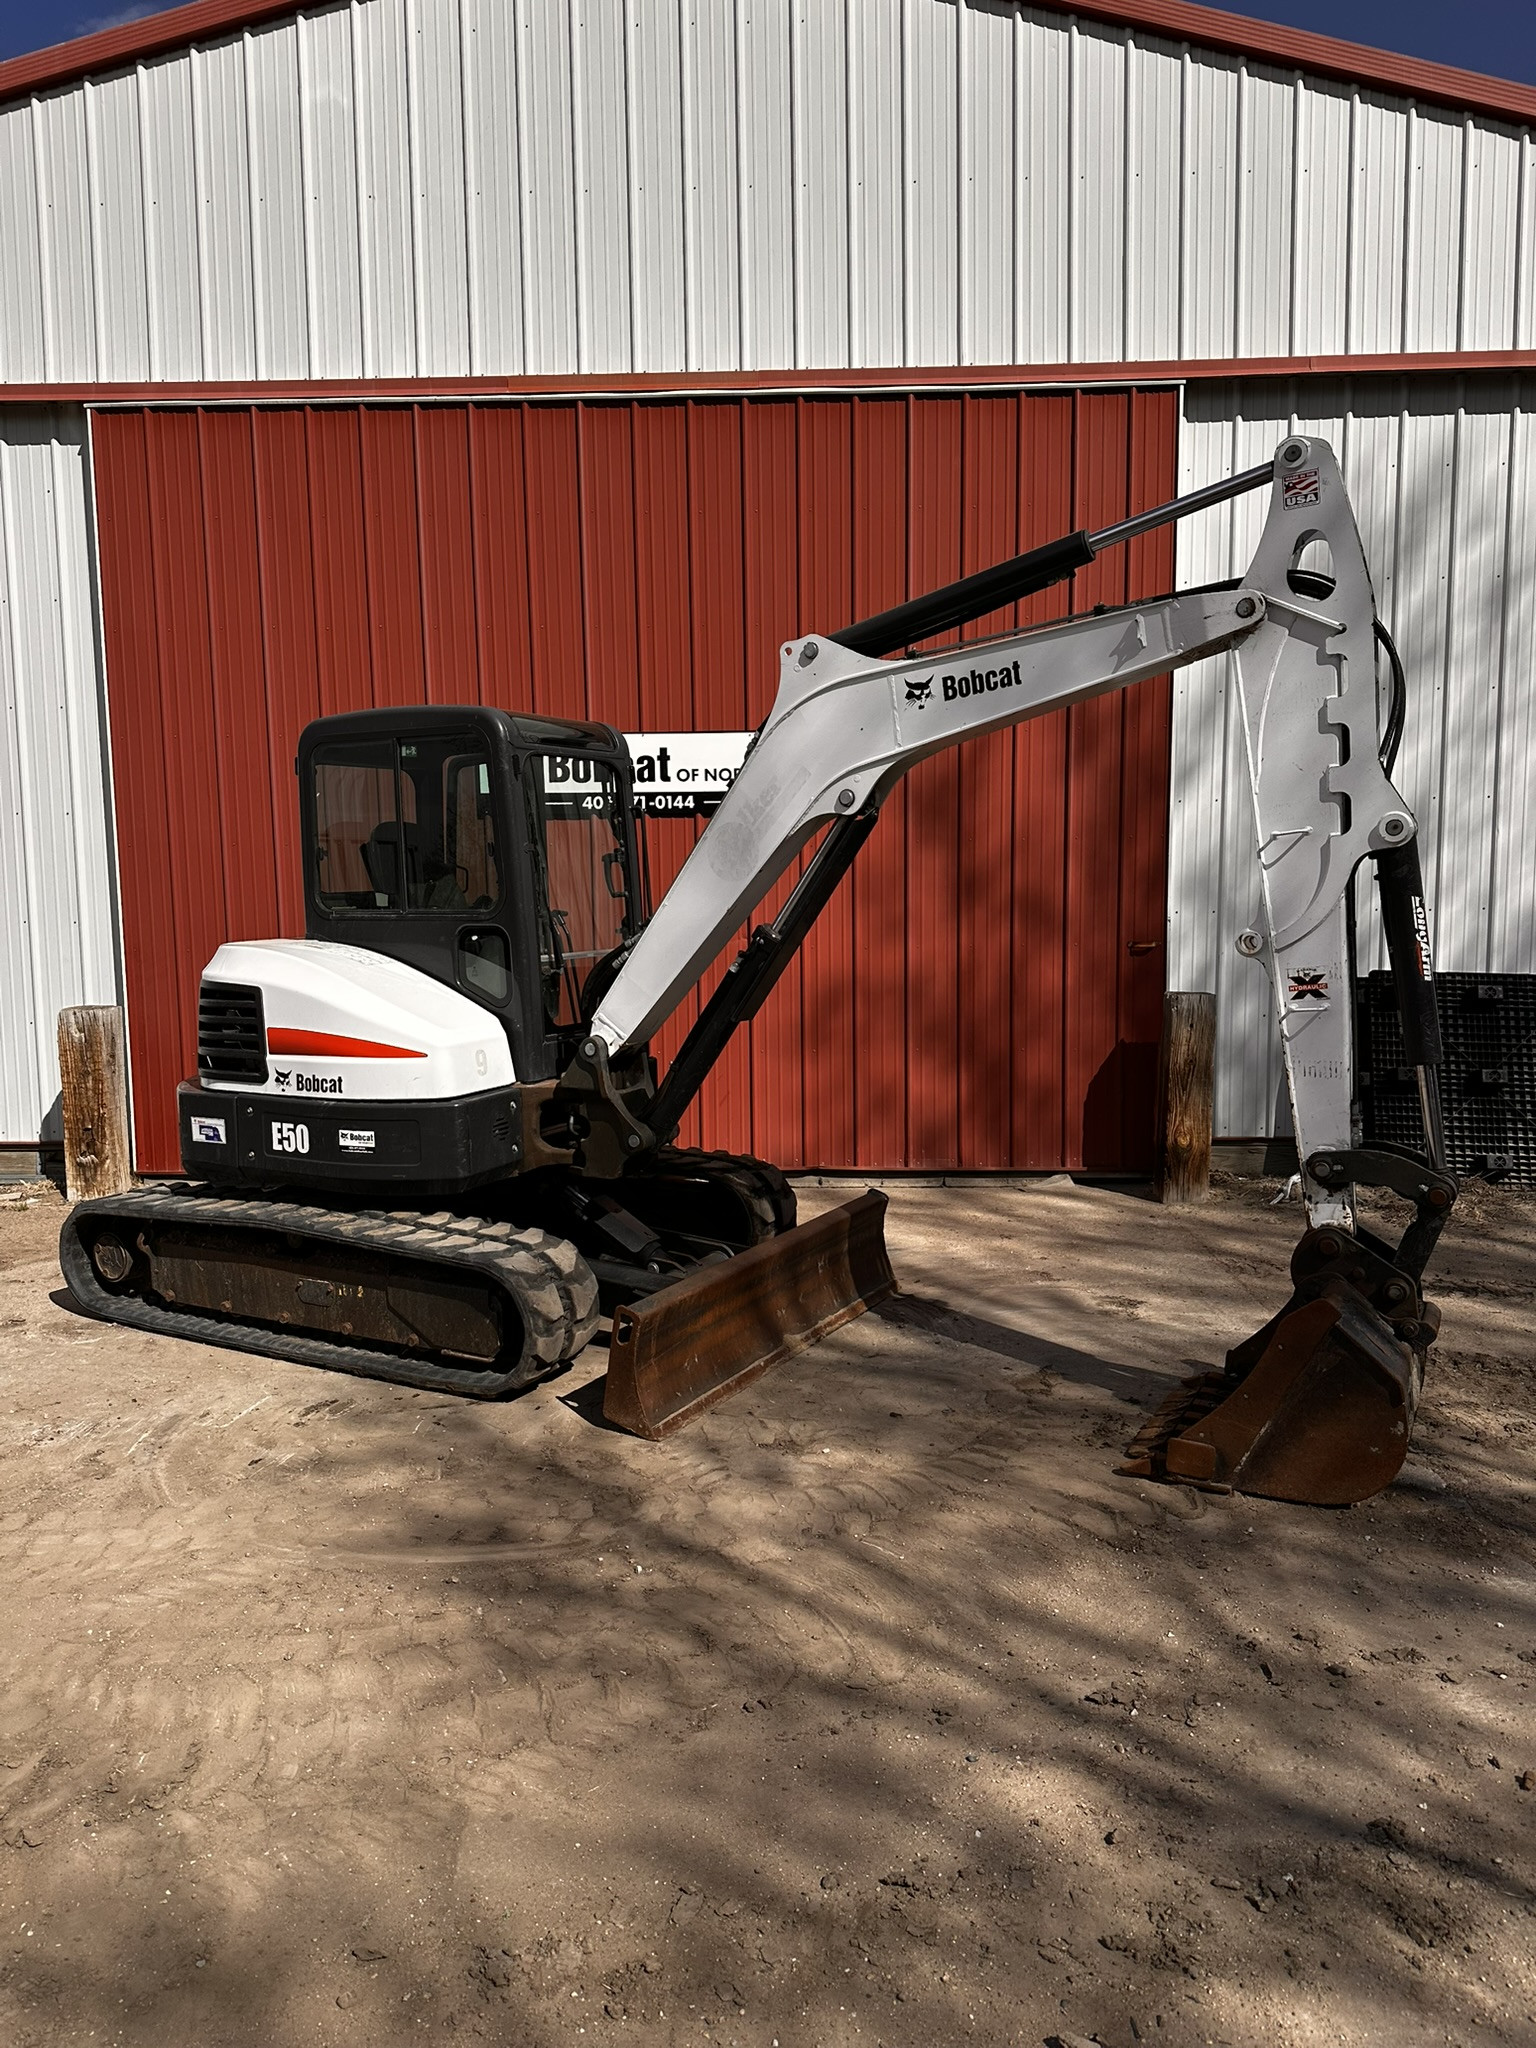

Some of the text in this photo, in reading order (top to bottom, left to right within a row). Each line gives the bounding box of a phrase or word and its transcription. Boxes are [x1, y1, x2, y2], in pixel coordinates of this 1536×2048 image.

[1286, 494, 1317, 505] USA
[942, 660, 1022, 702] Bobcat
[549, 747, 671, 783] Boat
[677, 768, 699, 782] OF
[1289, 983, 1328, 992] HYDRAULIC
[296, 1073, 343, 1094] Bobcat
[271, 1121, 310, 1154] E50
[350, 1132, 374, 1142] Bobcat
